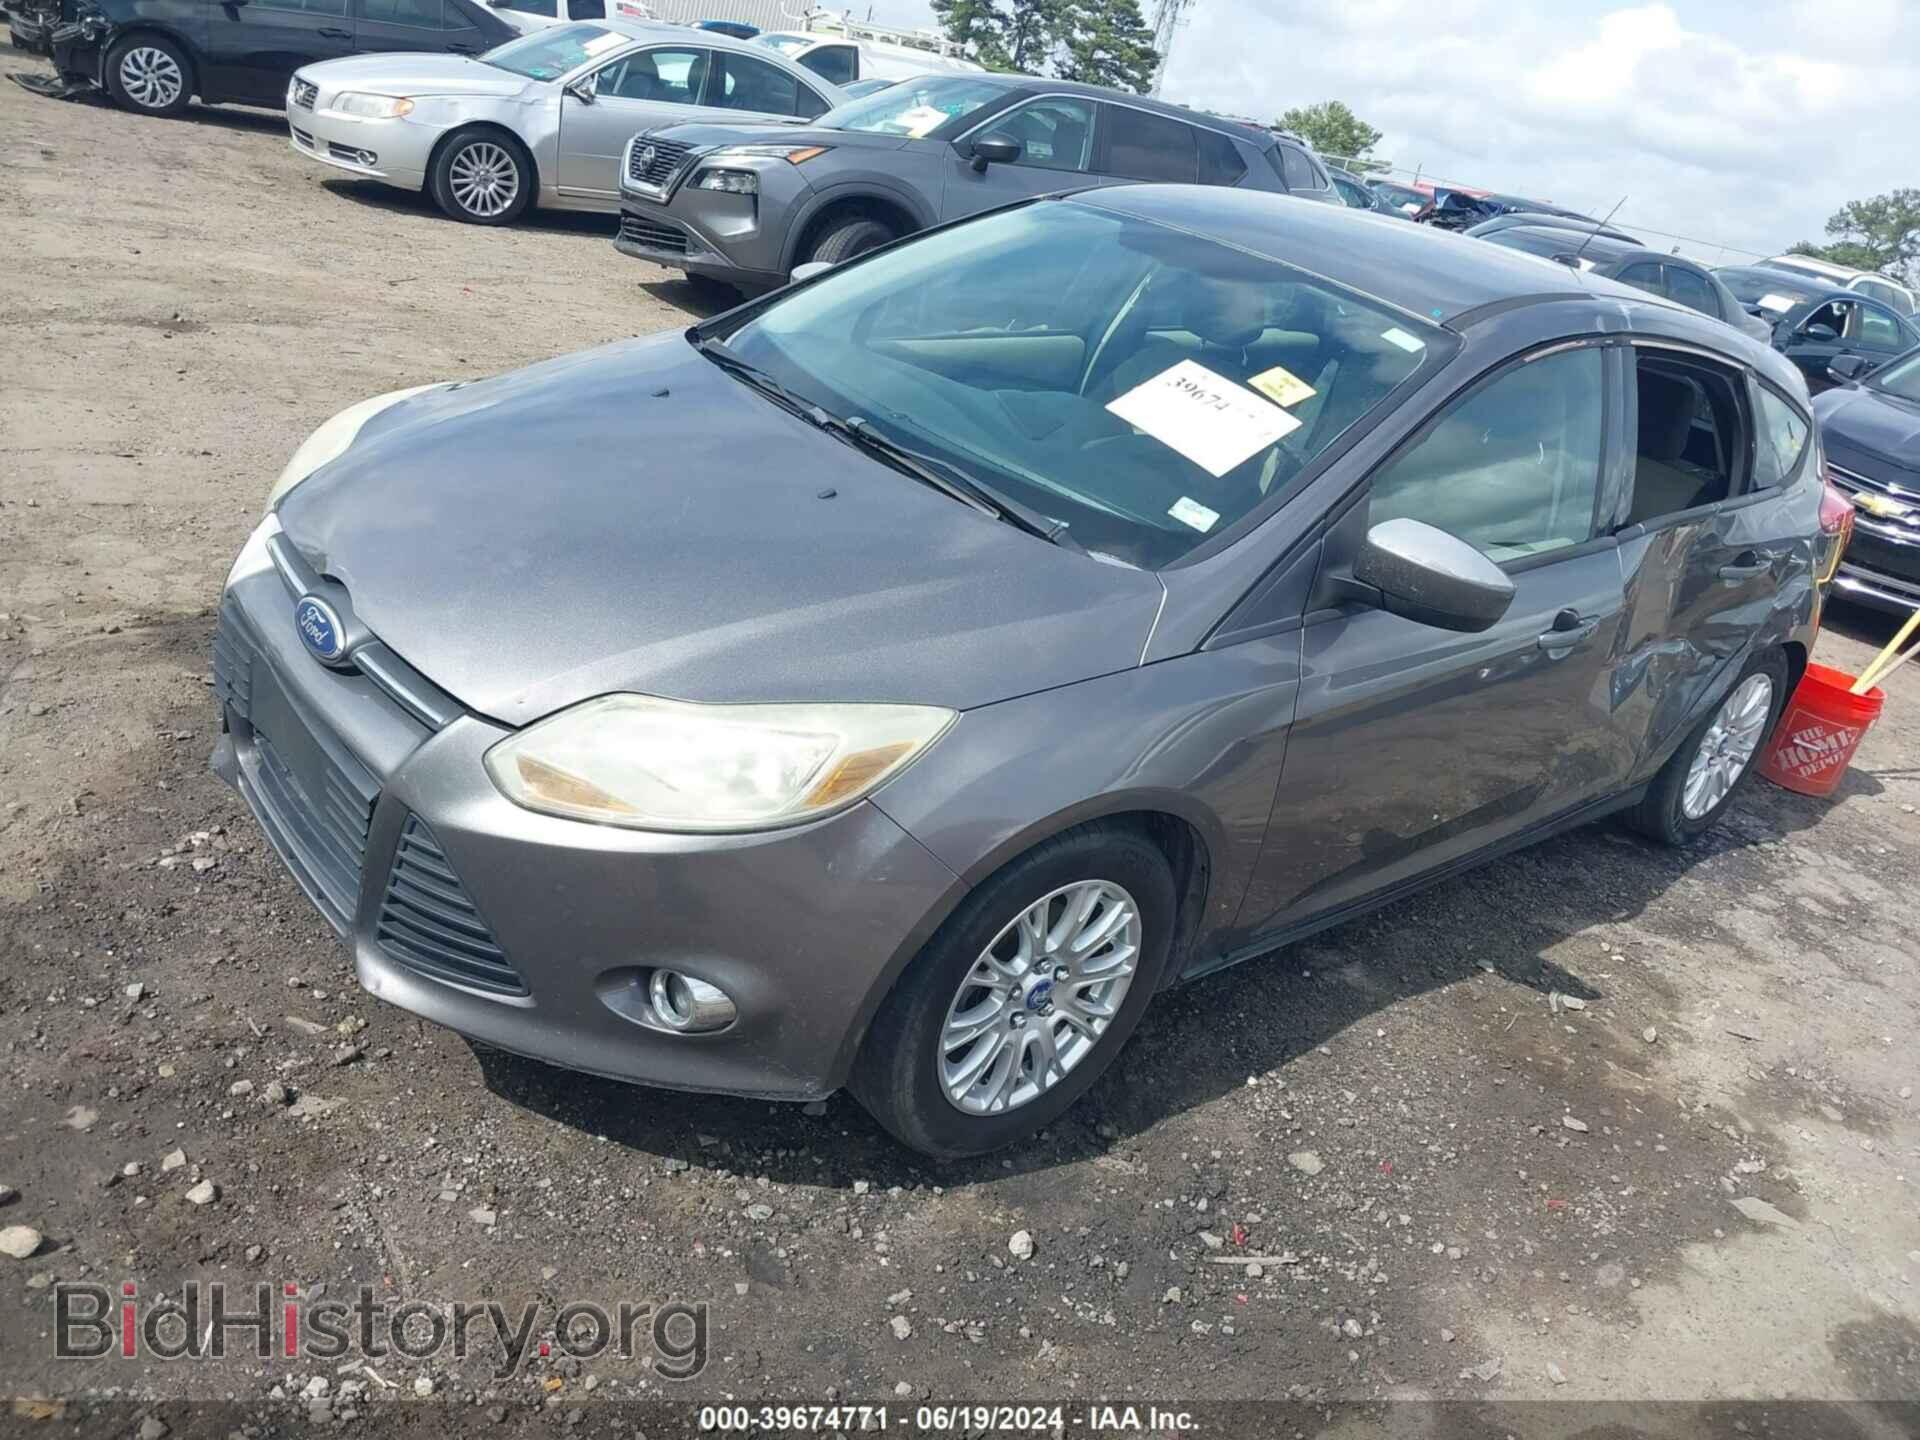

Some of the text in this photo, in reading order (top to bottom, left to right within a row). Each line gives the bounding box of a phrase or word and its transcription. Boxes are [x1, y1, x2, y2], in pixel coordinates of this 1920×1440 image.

[301, 606, 329, 646] Ford
[1776, 727, 1859, 772] HOME
[1792, 725, 1824, 742] THE
[1798, 750, 1845, 778] DEPOT
